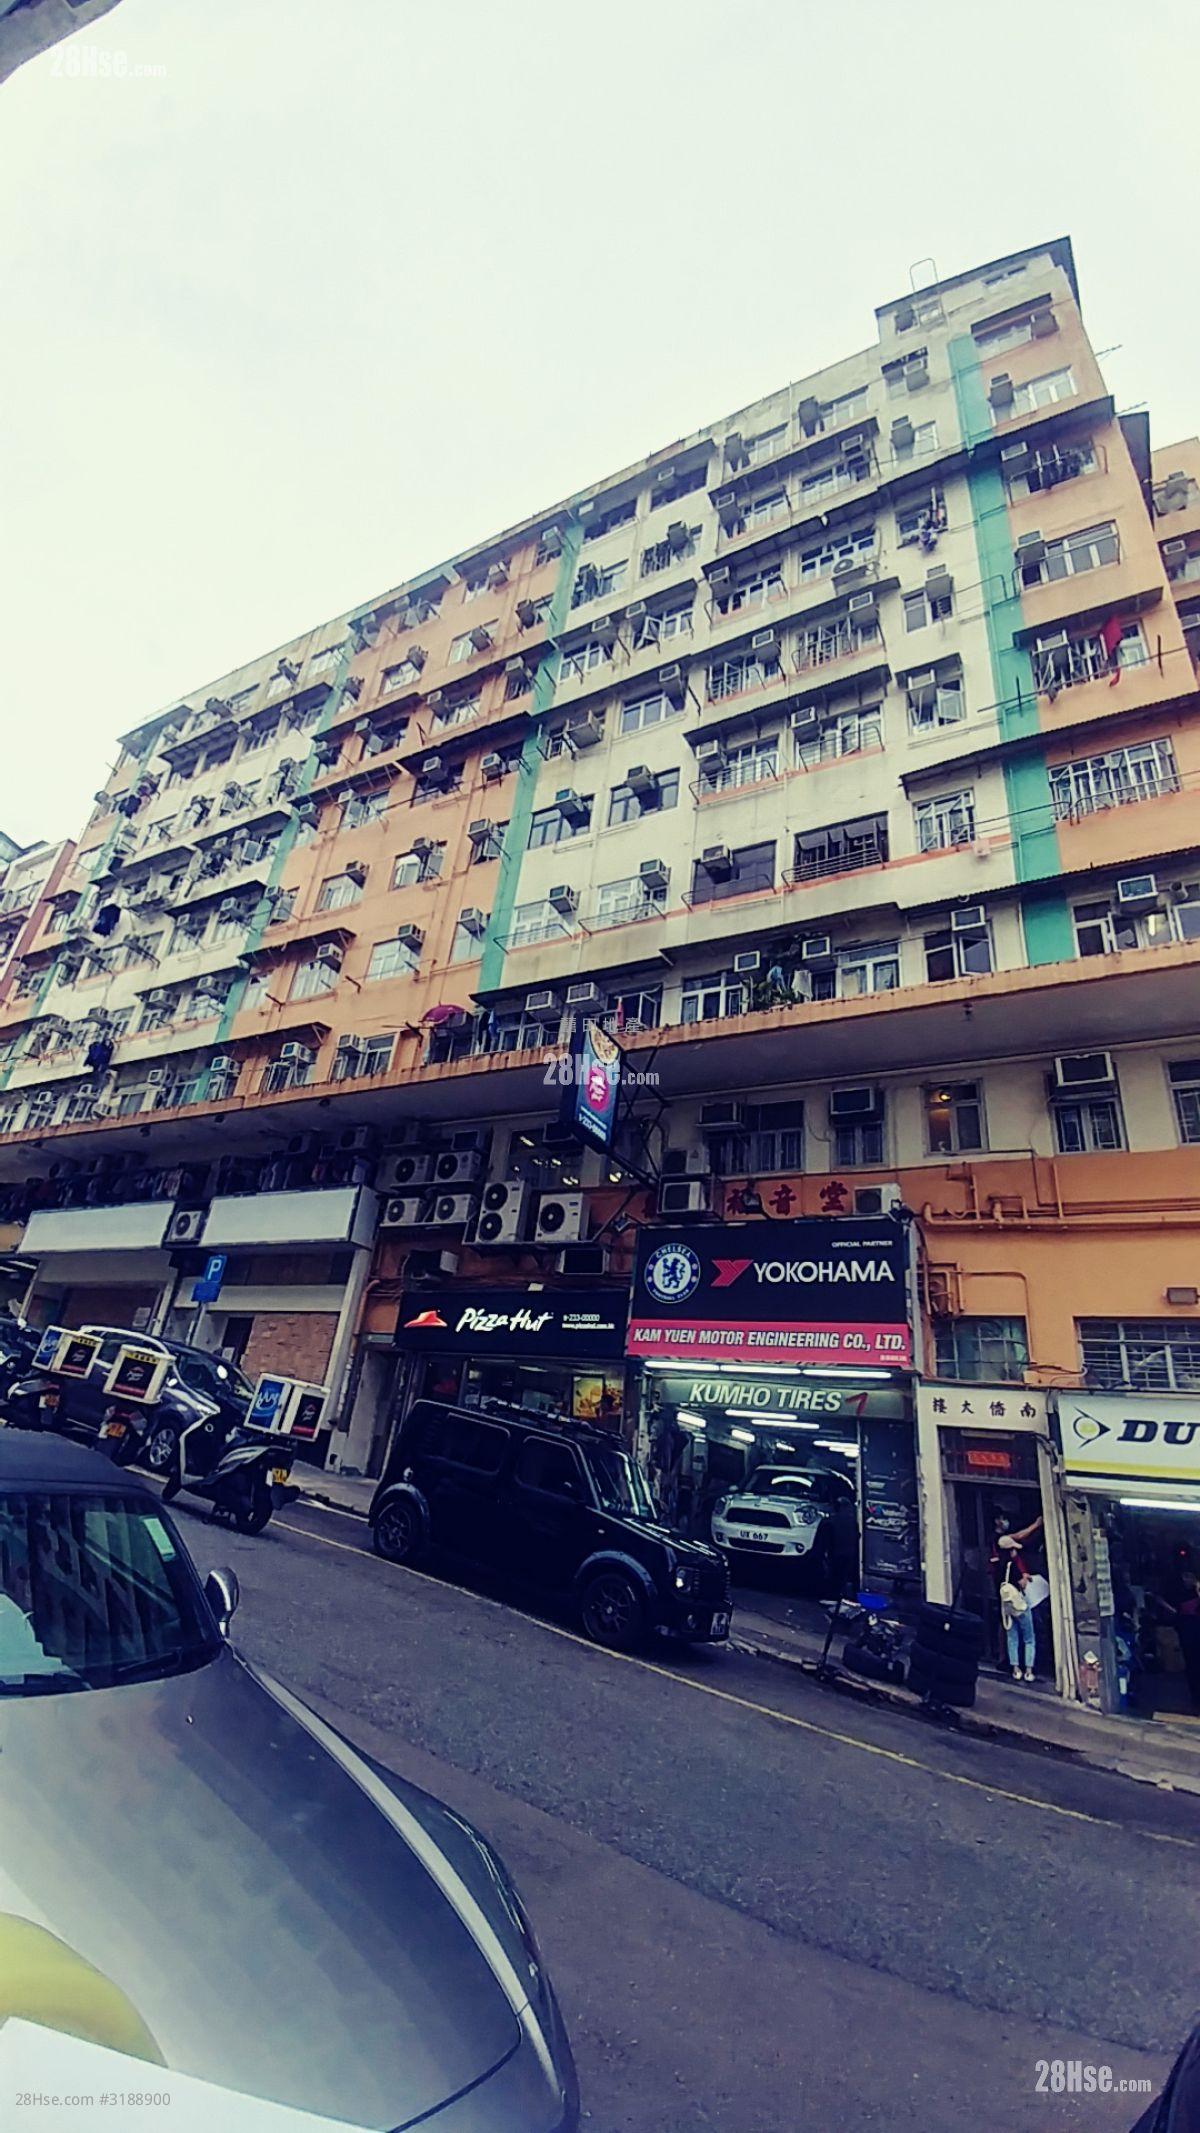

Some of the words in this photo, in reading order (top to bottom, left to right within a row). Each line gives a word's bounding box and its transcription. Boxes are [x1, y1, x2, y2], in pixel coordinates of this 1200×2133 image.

[207, 1259, 222, 1280] P
[753, 1260, 895, 1283] YOKOHAMA
[455, 1307, 509, 1333] Pizza
[509, 1308, 554, 1332] Hut
[633, 1328, 662, 1342] KAM
[664, 1329, 697, 1344] YUEN
[698, 1330, 744, 1345] MOTOR
[747, 1331, 840, 1348] ENGINEERING
[842, 1333, 871, 1351] CO.,
[874, 1334, 906, 1350] LTD.
[689, 1382, 772, 1407] KUMHO
[777, 1387, 842, 1412] TIRES
